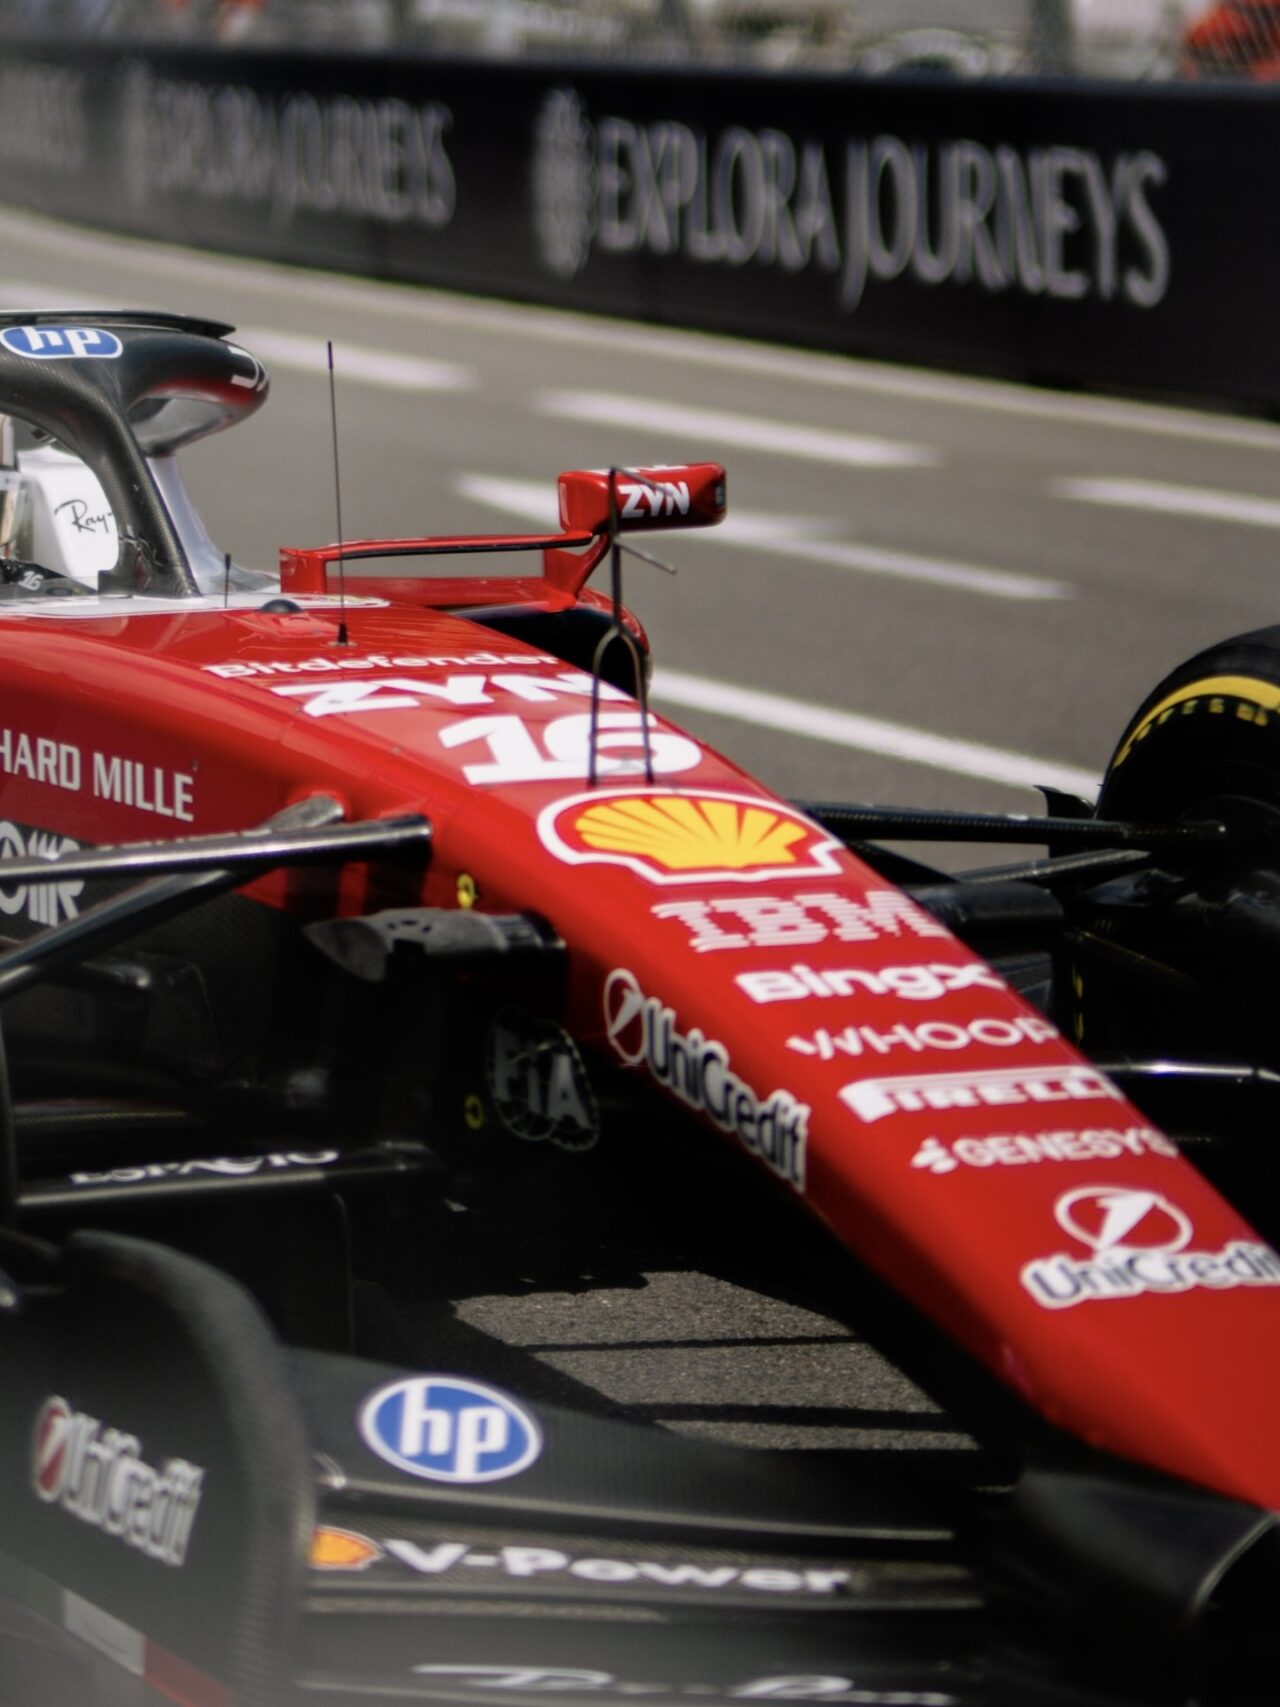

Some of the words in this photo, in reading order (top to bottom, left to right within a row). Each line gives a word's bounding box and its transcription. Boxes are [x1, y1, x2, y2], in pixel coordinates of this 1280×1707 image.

[594, 116, 840, 270] EXPLORA
[841, 134, 1170, 308] JOURNEYS
[54, 499, 113, 534] Ray-
[618, 482, 690, 518] ZYN
[201, 653, 560, 679] Bitdefender
[271, 673, 634, 718] ZYN
[438, 712, 702, 786] 16
[93, 752, 194, 823] MILLE
[650, 890, 952, 953] IBM
[785, 1018, 1059, 1061] WHOOP
[494, 1022, 593, 1130] FIA
[645, 1002, 804, 1184] UniCredit
[953, 1128, 1178, 1168] GENESYS
[399, 1382, 508, 1480] hp
[383, 1539, 852, 1593] V-Power
